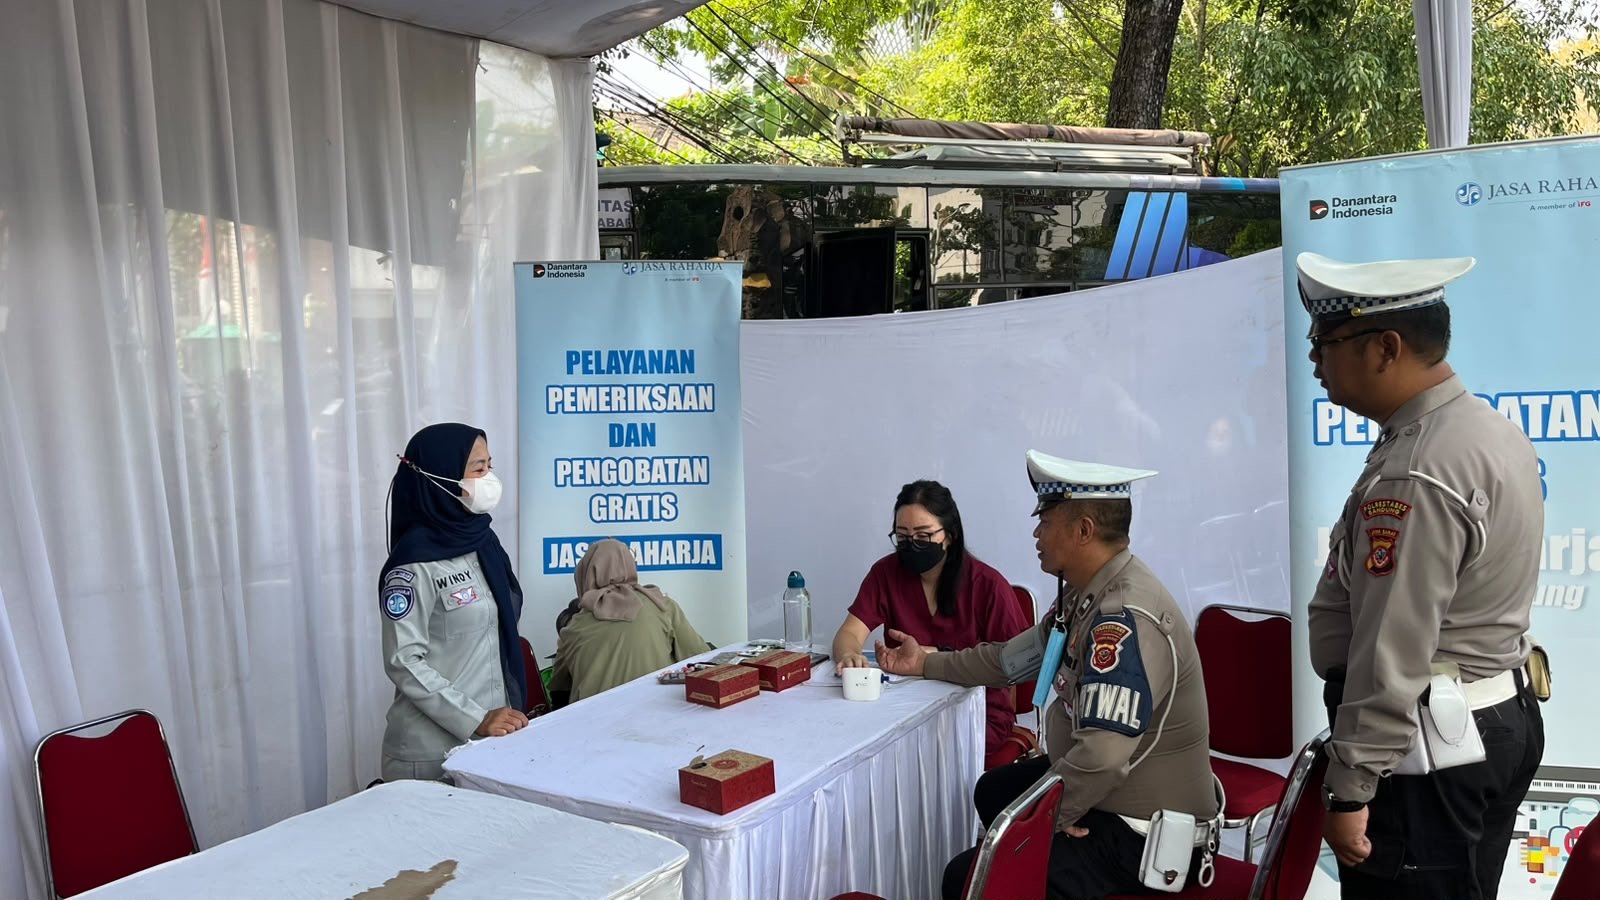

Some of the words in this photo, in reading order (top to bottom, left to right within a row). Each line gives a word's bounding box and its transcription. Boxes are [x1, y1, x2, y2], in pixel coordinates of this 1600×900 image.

[1332, 194, 1397, 207] Danantara
[1488, 182, 1532, 200] JASA
[1332, 204, 1393, 219] Indonesia
[547, 263, 588, 271] Danantara
[640, 262, 666, 272] JASA
[669, 262, 723, 272] RAHARJA
[566, 350, 695, 375] PELAYANAN
[546, 383, 715, 414] PEMERIKSAAN
[608, 423, 656, 448] DAN
[554, 456, 709, 487] PENGOBATAN
[589, 492, 678, 523] GRATIS
[1363, 501, 1408, 512] POLRESTABES
[1368, 506, 1400, 515] BANDUNG
[549, 543, 588, 569] JAS
[629, 539, 716, 568] AHARJA
[436, 570, 472, 590] WINDY
